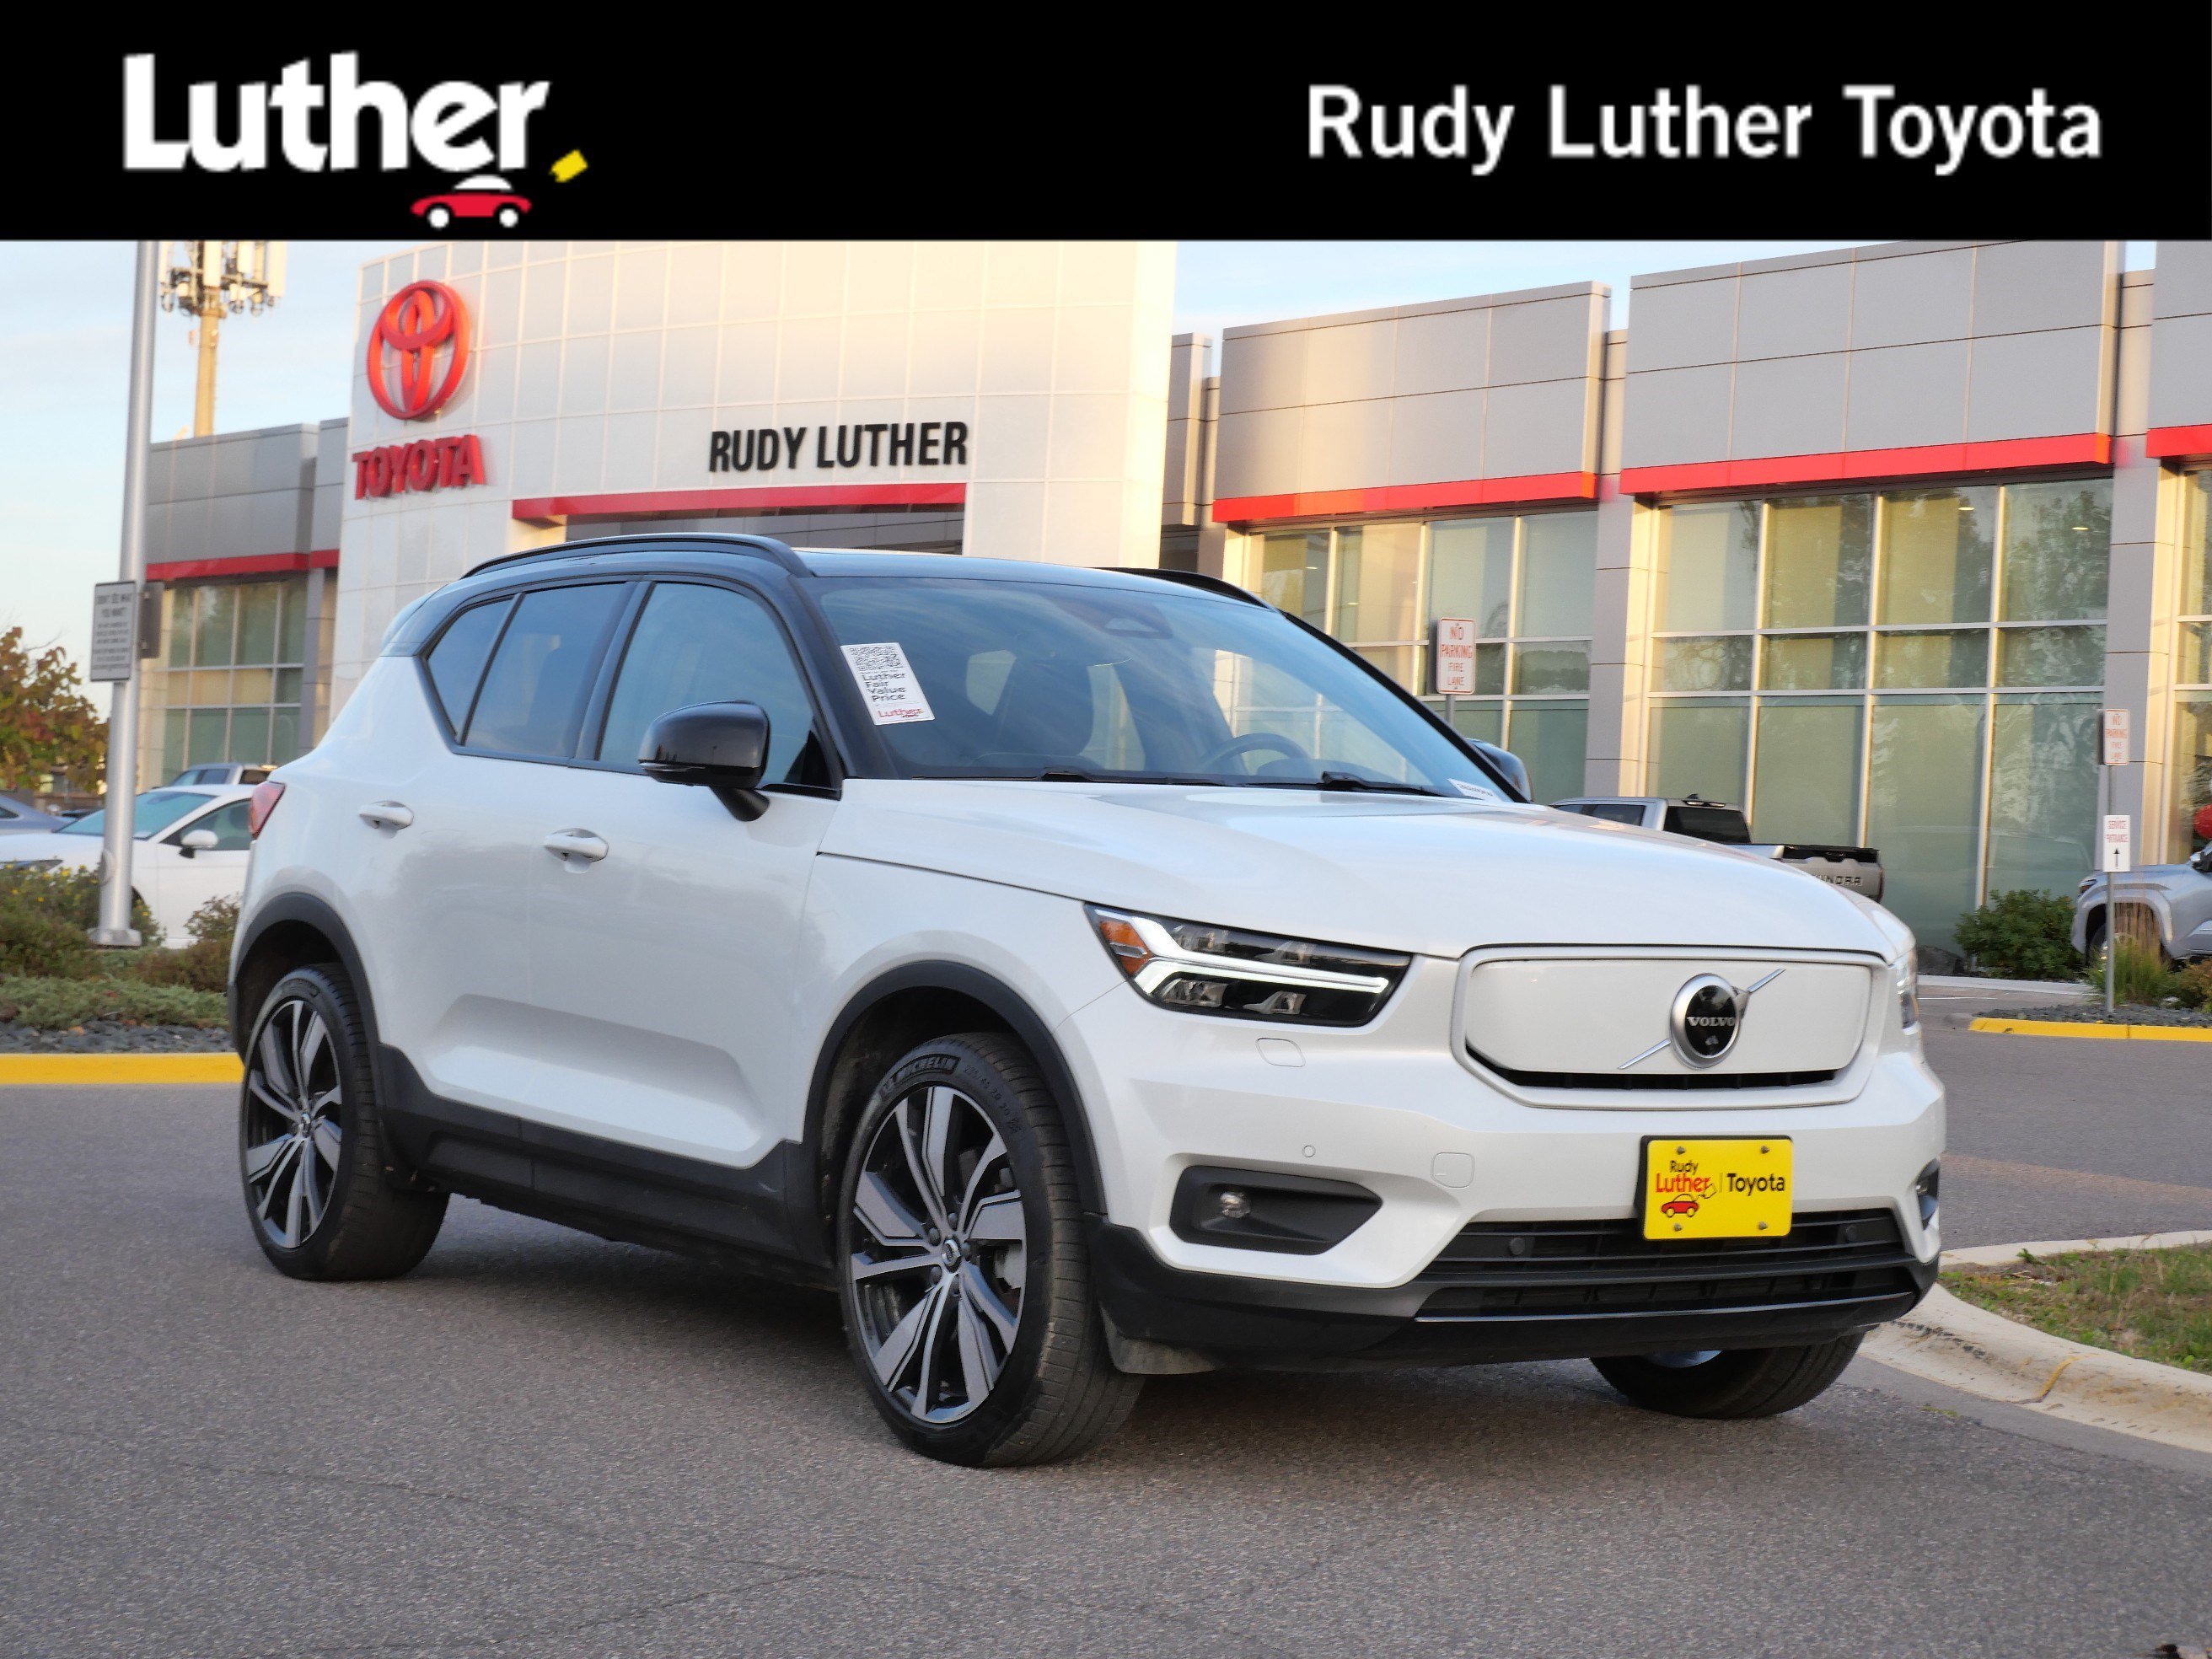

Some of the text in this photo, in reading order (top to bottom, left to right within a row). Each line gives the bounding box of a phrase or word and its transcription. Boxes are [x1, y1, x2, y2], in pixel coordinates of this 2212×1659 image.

[709, 421, 969, 473] RUDY LUTHER
[352, 434, 487, 501] TOYOTA
[1449, 626, 1464, 641] NO
[1440, 644, 1473, 658] PARKING
[1447, 662, 1463, 673] FIRE
[1447, 677, 1465, 686] LANE
[878, 708, 922, 717] Luther
[1686, 1016, 1736, 1027] VOLVO
[1670, 1160, 1699, 1175] Rudy
[1656, 1173, 1785, 1196] Luther Toyota
